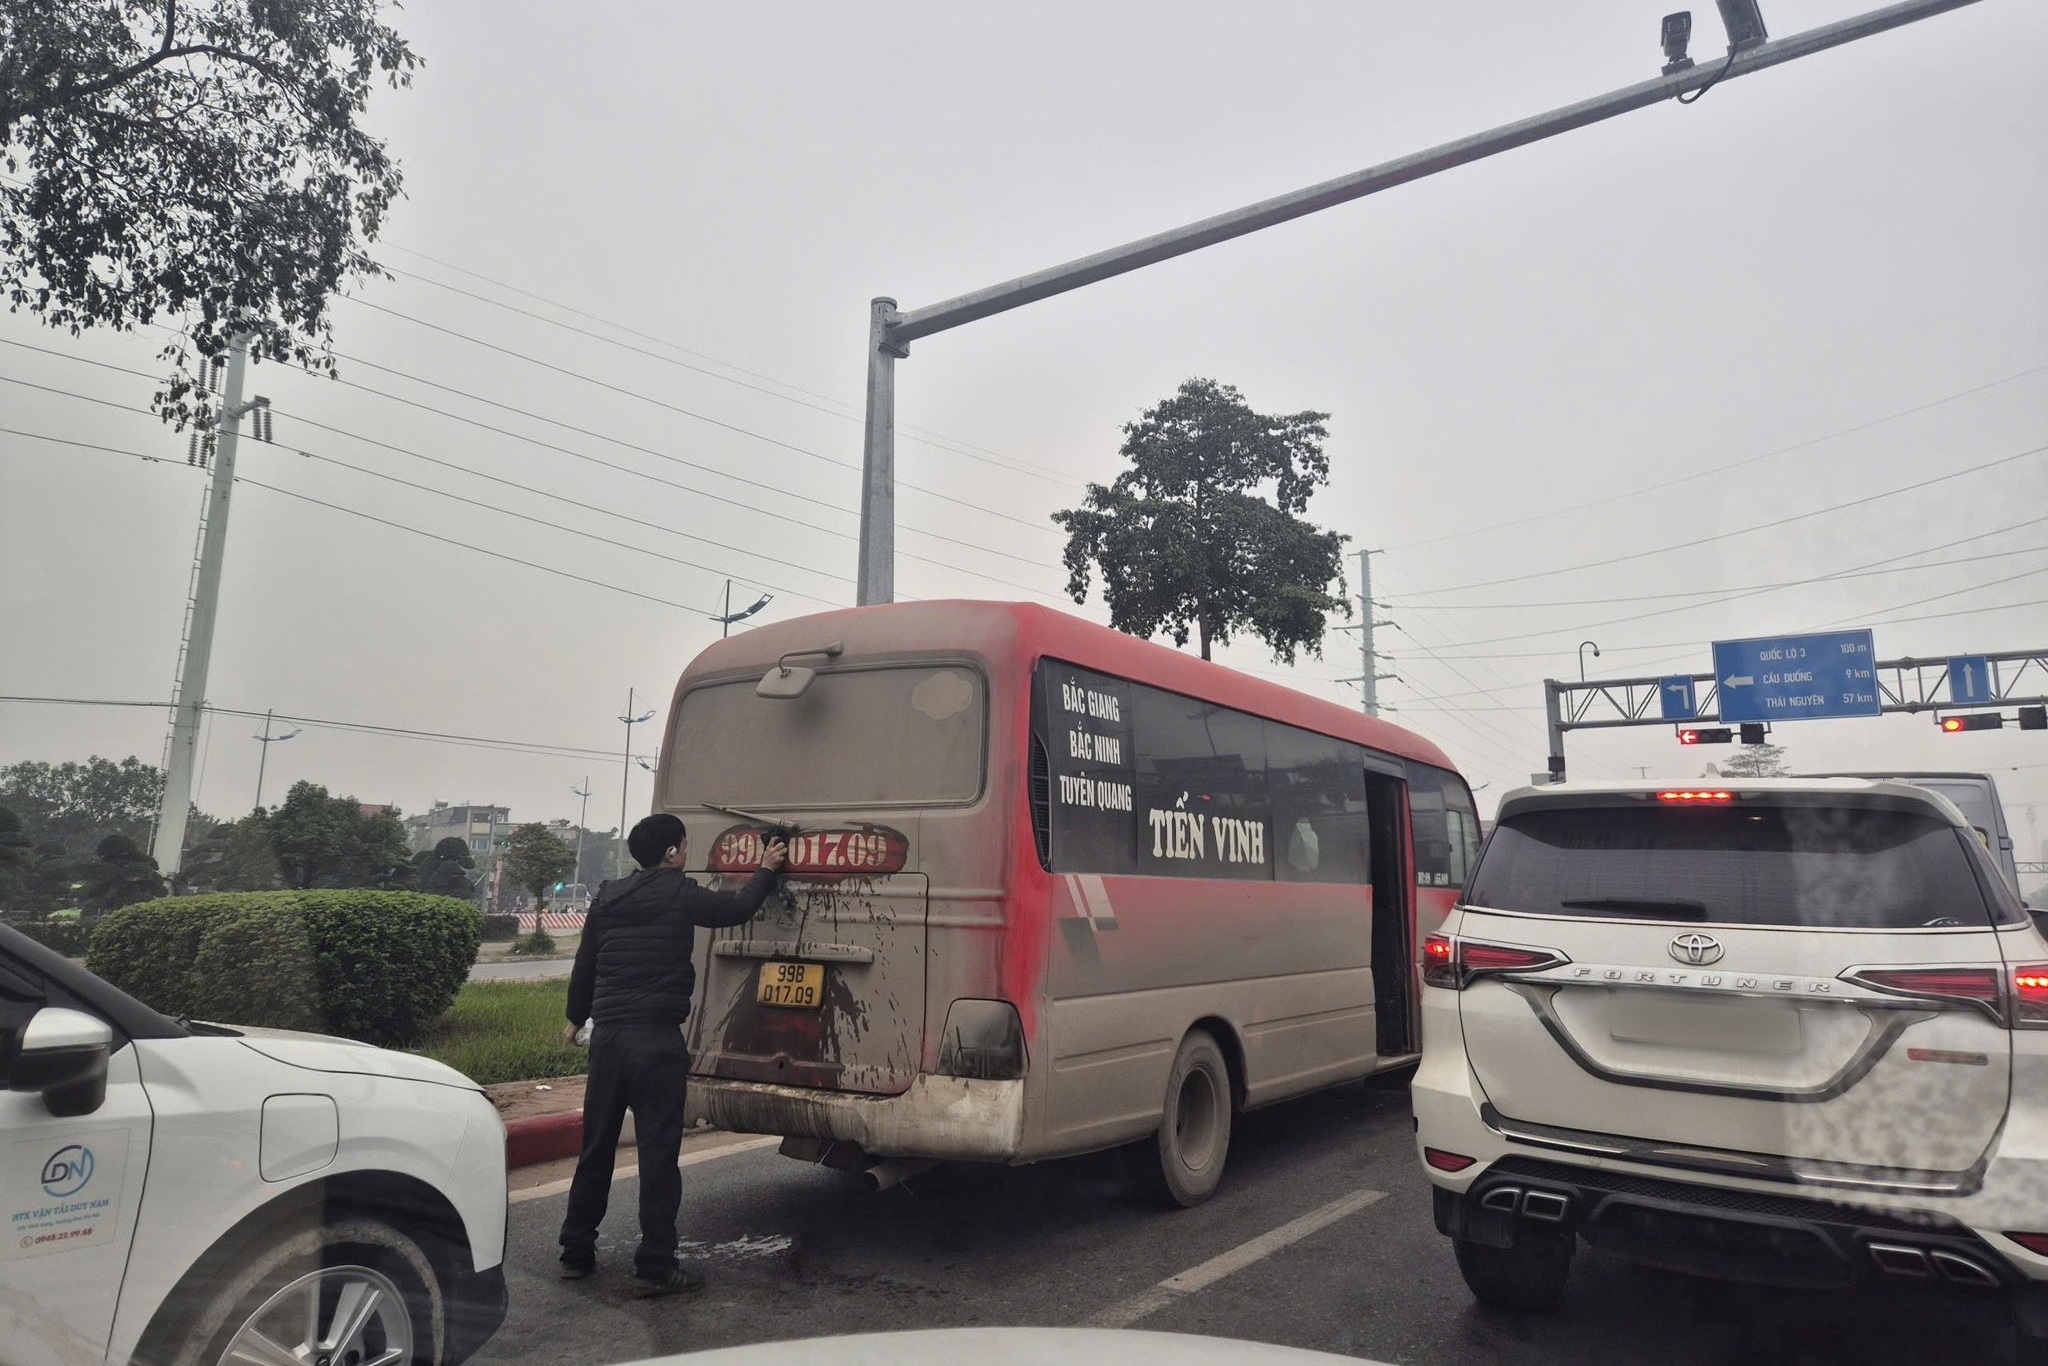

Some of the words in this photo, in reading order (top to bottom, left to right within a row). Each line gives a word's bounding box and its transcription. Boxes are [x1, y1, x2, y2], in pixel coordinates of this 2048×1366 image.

[1760, 646, 1782, 661] QUỐC
[1785, 648, 1797, 660] LỘ
[1799, 647, 1806, 658] 3
[1840, 643, 1855, 653] 100
[1857, 644, 1867, 653] m
[1845, 668, 1851, 679] 9
[1854, 668, 1870, 679] km
[1062, 676, 1086, 714] BẮC
[1087, 690, 1120, 722] GIANG
[1765, 695, 1786, 708] THÁI
[1789, 694, 1824, 707] NGUYÊN
[1843, 693, 1854, 704] 57
[1857, 693, 1873, 703] km
[1069, 720, 1092, 760] BẮC
[1094, 734, 1121, 765] NINH
[1059, 771, 1095, 807] TUYÊN
[1097, 780, 1133, 811] QUANG
[788, 833, 887, 867] 017.09
[1212, 816, 1265, 864] VINH
[777, 965, 805, 983] 99B
[1573, 967, 1831, 993] FORTUNER
[763, 984, 814, 1004] 017.09
